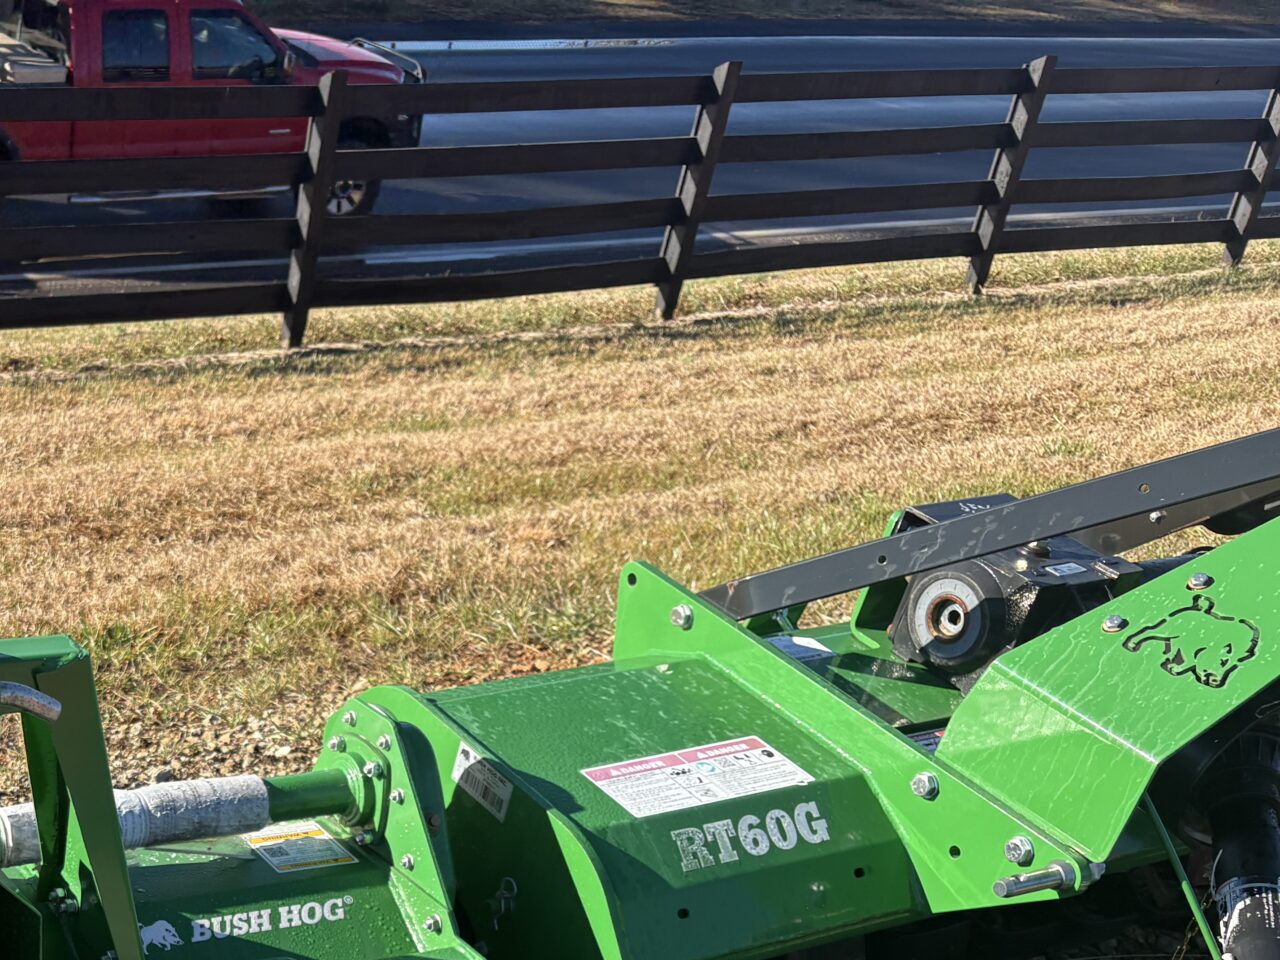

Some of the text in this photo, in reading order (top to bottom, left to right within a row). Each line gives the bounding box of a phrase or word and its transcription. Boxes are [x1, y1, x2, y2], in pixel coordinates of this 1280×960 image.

[707, 743, 750, 757] DANGER
[620, 761, 666, 774] DANGER
[670, 801, 830, 872] RT60G
[191, 909, 272, 942] BUSH
